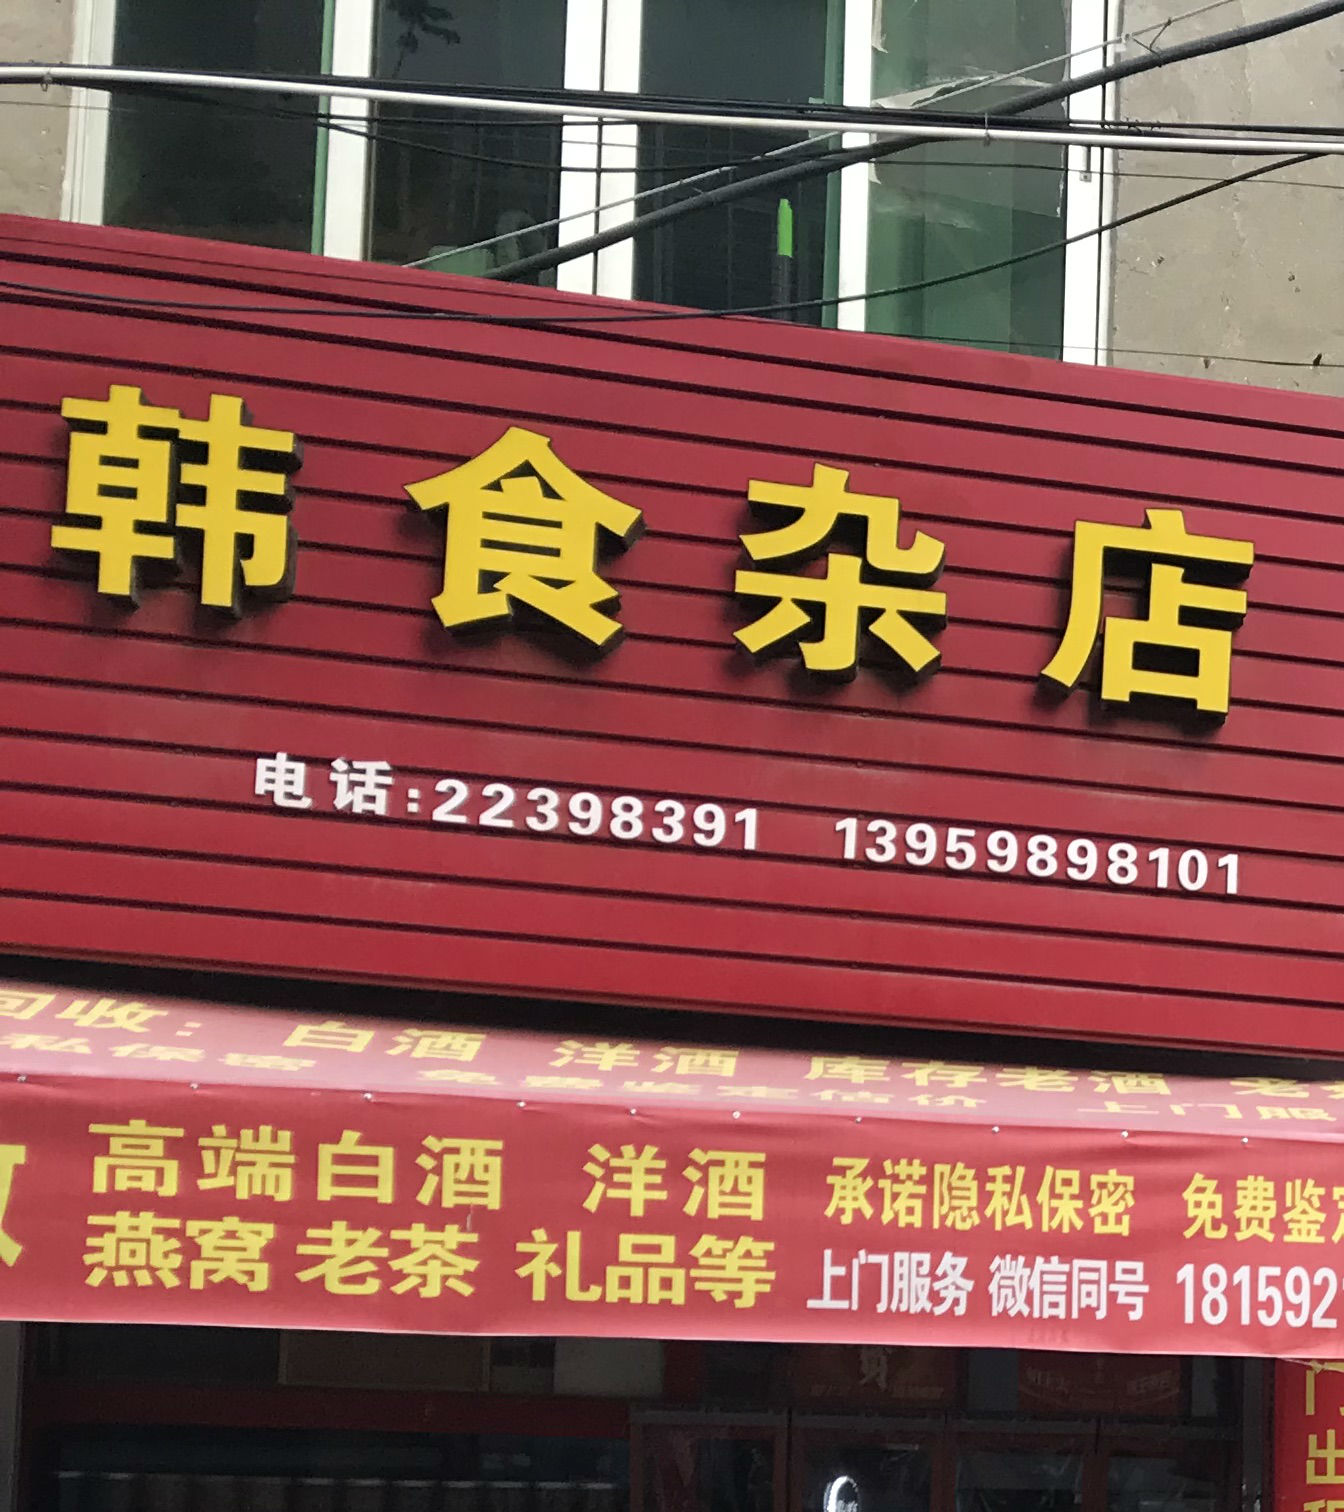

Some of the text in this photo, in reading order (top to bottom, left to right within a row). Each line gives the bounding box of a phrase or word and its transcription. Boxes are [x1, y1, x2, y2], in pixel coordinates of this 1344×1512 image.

[49, 384, 1256, 716] 韩食杂店
[834, 816, 1242, 895] 13959898101
[282, 1020, 488, 1063] 白酒
[548, 1039, 740, 1079] 洋酒
[803, 1055, 1172, 1096] 库存老酒
[88, 1119, 504, 1211] 高端白酒
[582, 1144, 767, 1222] 洋酒
[825, 1157, 1137, 1237] 承诺隐私保密
[83, 1210, 276, 1292] 燕窝
[296, 1220, 481, 1298] 老茶
[516, 1228, 777, 1309] 礼品等
[806, 1249, 976, 1317] 上门服务
[988, 1253, 1151, 1322] 微信同号
